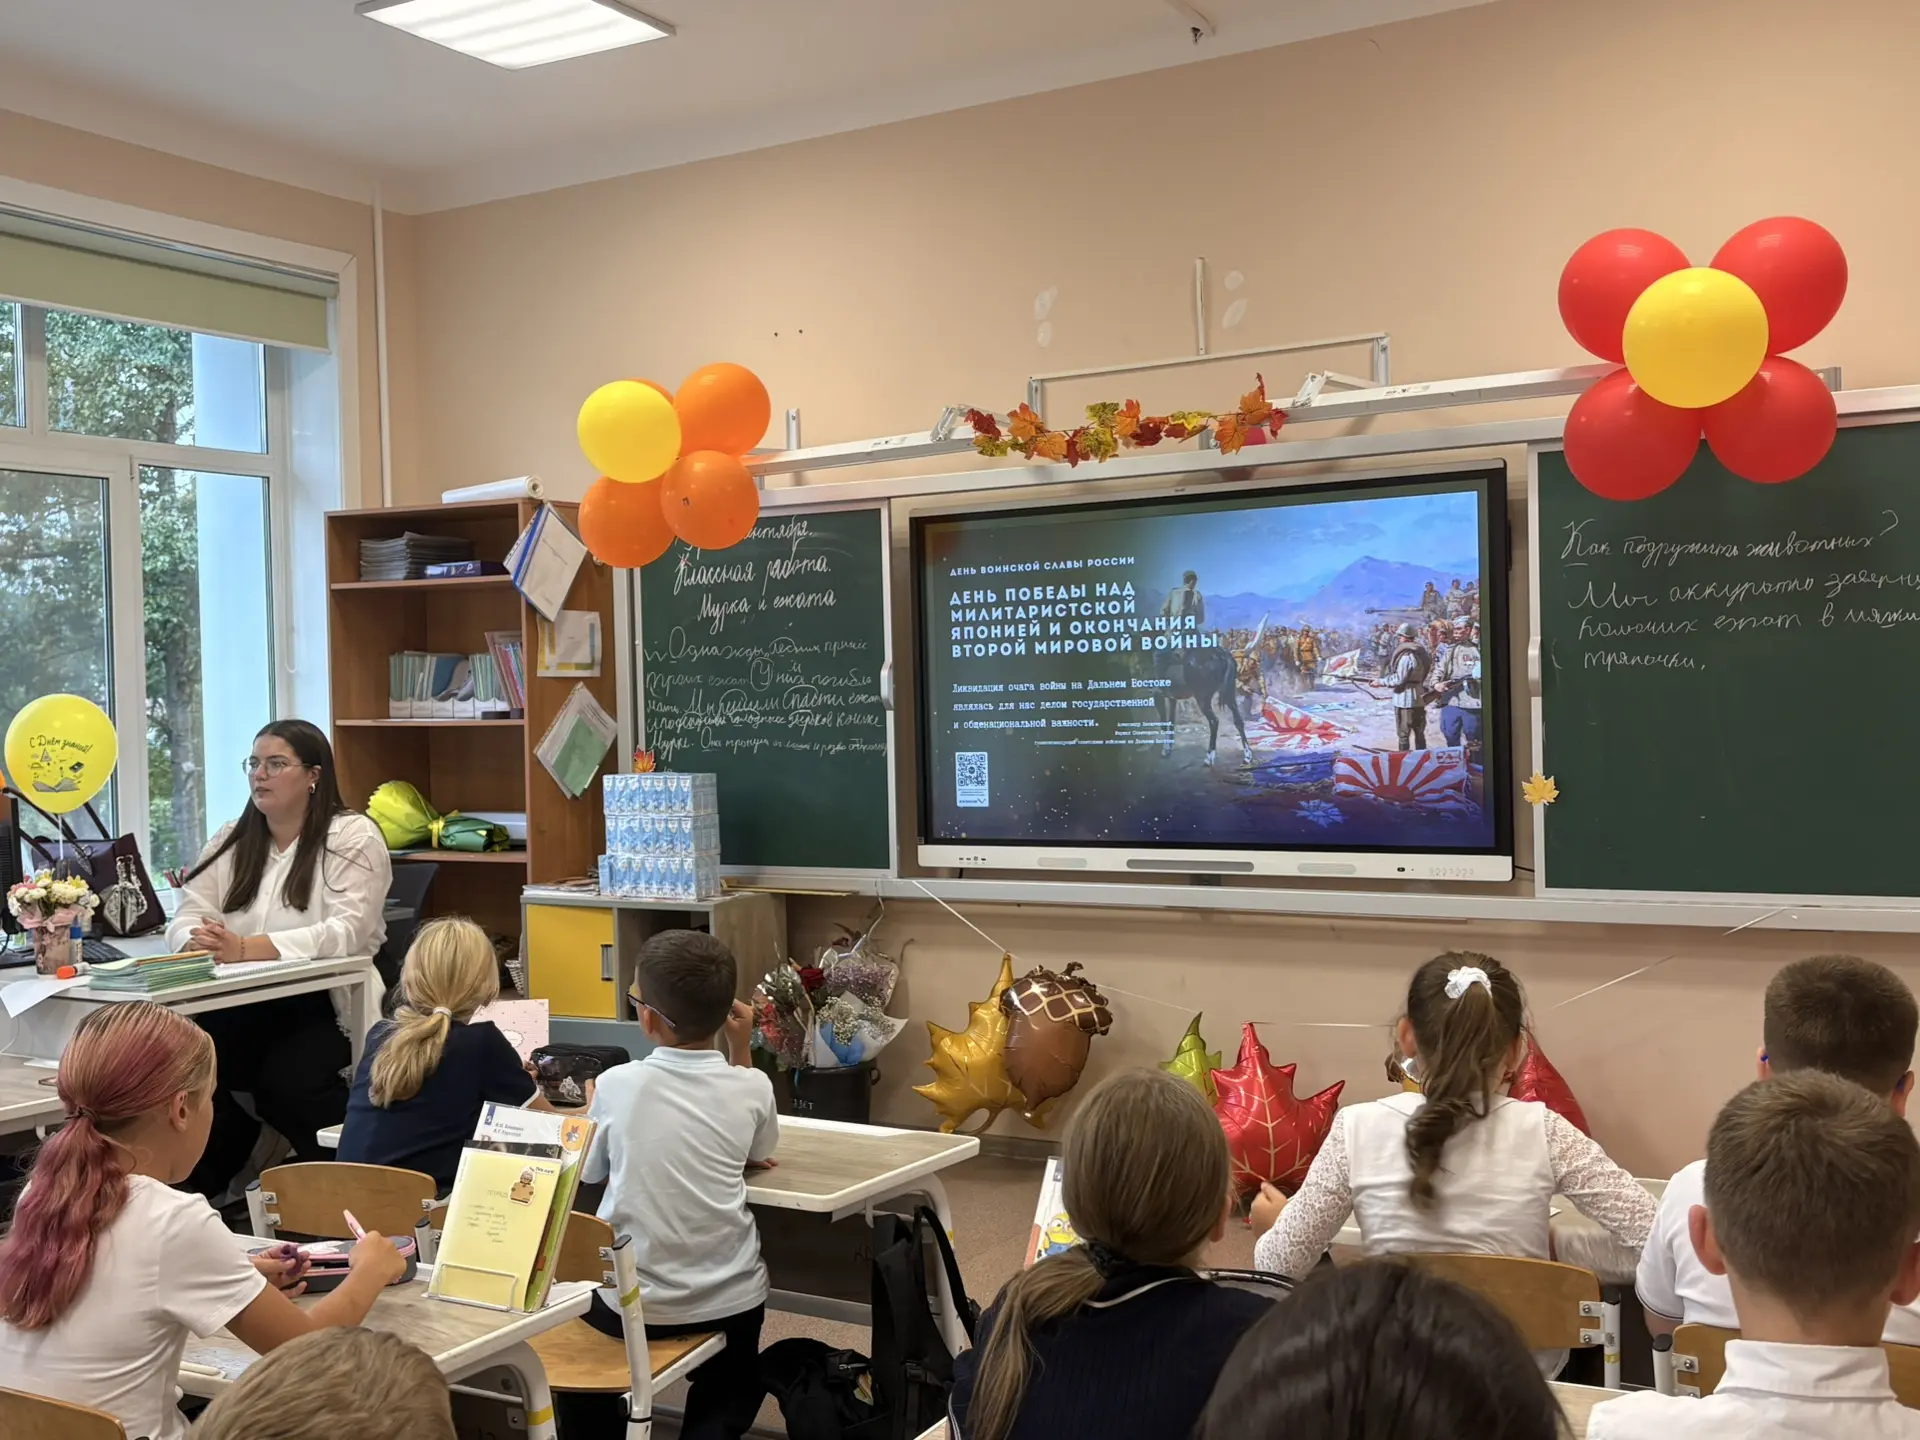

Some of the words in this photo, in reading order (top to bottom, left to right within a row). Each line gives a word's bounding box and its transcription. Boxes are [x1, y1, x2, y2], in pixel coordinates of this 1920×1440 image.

[1561, 519, 1612, 559] Как
[950, 567, 977, 577] ДЕНЬ
[980, 560, 1040, 574] ВОИНСКОЙ
[1044, 559, 1083, 571] СЛАВЫ
[1087, 556, 1135, 568] РОССИИ
[950, 590, 998, 606] ДЕНЬ
[1005, 584, 1087, 602] ПОБЕДЫ
[1095, 581, 1136, 598] НАД
[696, 593, 752, 635] Мурка
[773, 588, 837, 609] ежата
[950, 597, 1136, 622] МИЛИТАРИСТСКОЙ
[951, 620, 1041, 640] ЯПОНИЕЙ
[1049, 622, 1061, 636] И
[1069, 615, 1197, 635] ОКОНЧАНИЯ
[951, 639, 1026, 658] ВТОРОЙ
[1034, 634, 1133, 655] МИРОВОЙ
[1141, 632, 1219, 651] ВОЙНЫ
[952, 683, 1004, 694] Ликвидация
[1008, 683, 1035, 692] очага
[1040, 681, 1067, 691] войны
[1071, 682, 1083, 690] на
[1087, 680, 1127, 691] Дальнем
[1131, 678, 1172, 688] Востоке
[953, 703, 994, 712] являлась
[998, 702, 1015, 711] для
[1019, 701, 1035, 710] нас
[1040, 701, 1067, 711] делом
[1072, 698, 1155, 710] государственной
[953, 721, 959, 729] и
[963, 718, 1046, 730] общенациональной
[1051, 718, 1099, 728] важности.
